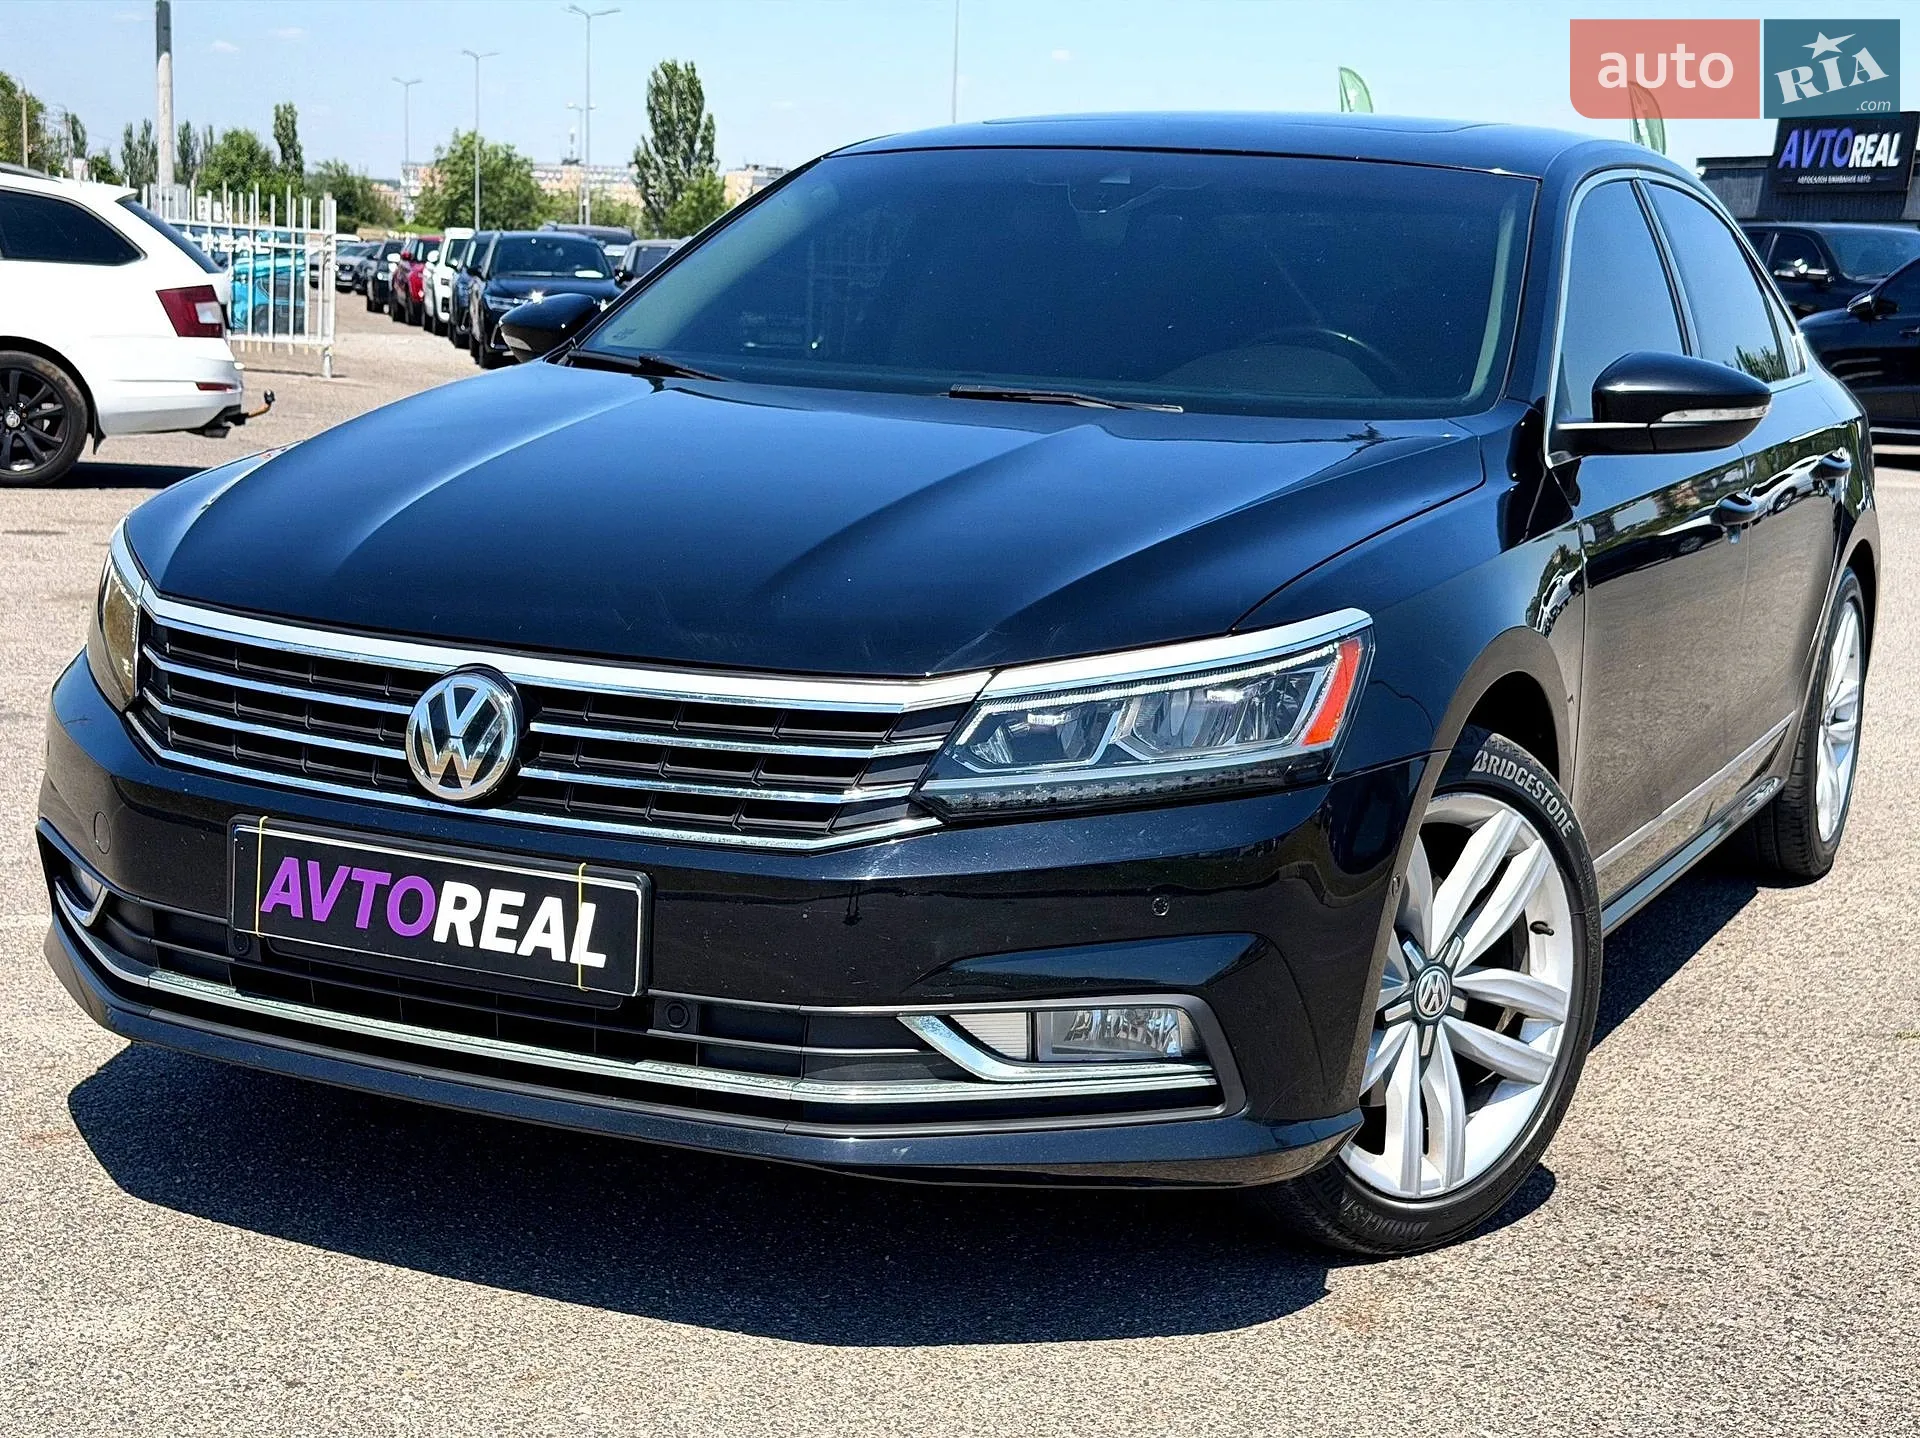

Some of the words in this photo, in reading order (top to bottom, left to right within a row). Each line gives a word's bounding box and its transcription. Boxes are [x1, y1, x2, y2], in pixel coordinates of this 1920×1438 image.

[1777, 127, 1901, 168] AVTOREAL
[1471, 749, 1575, 838] BRIDGESTONE
[259, 856, 607, 968] AVTOREAL
